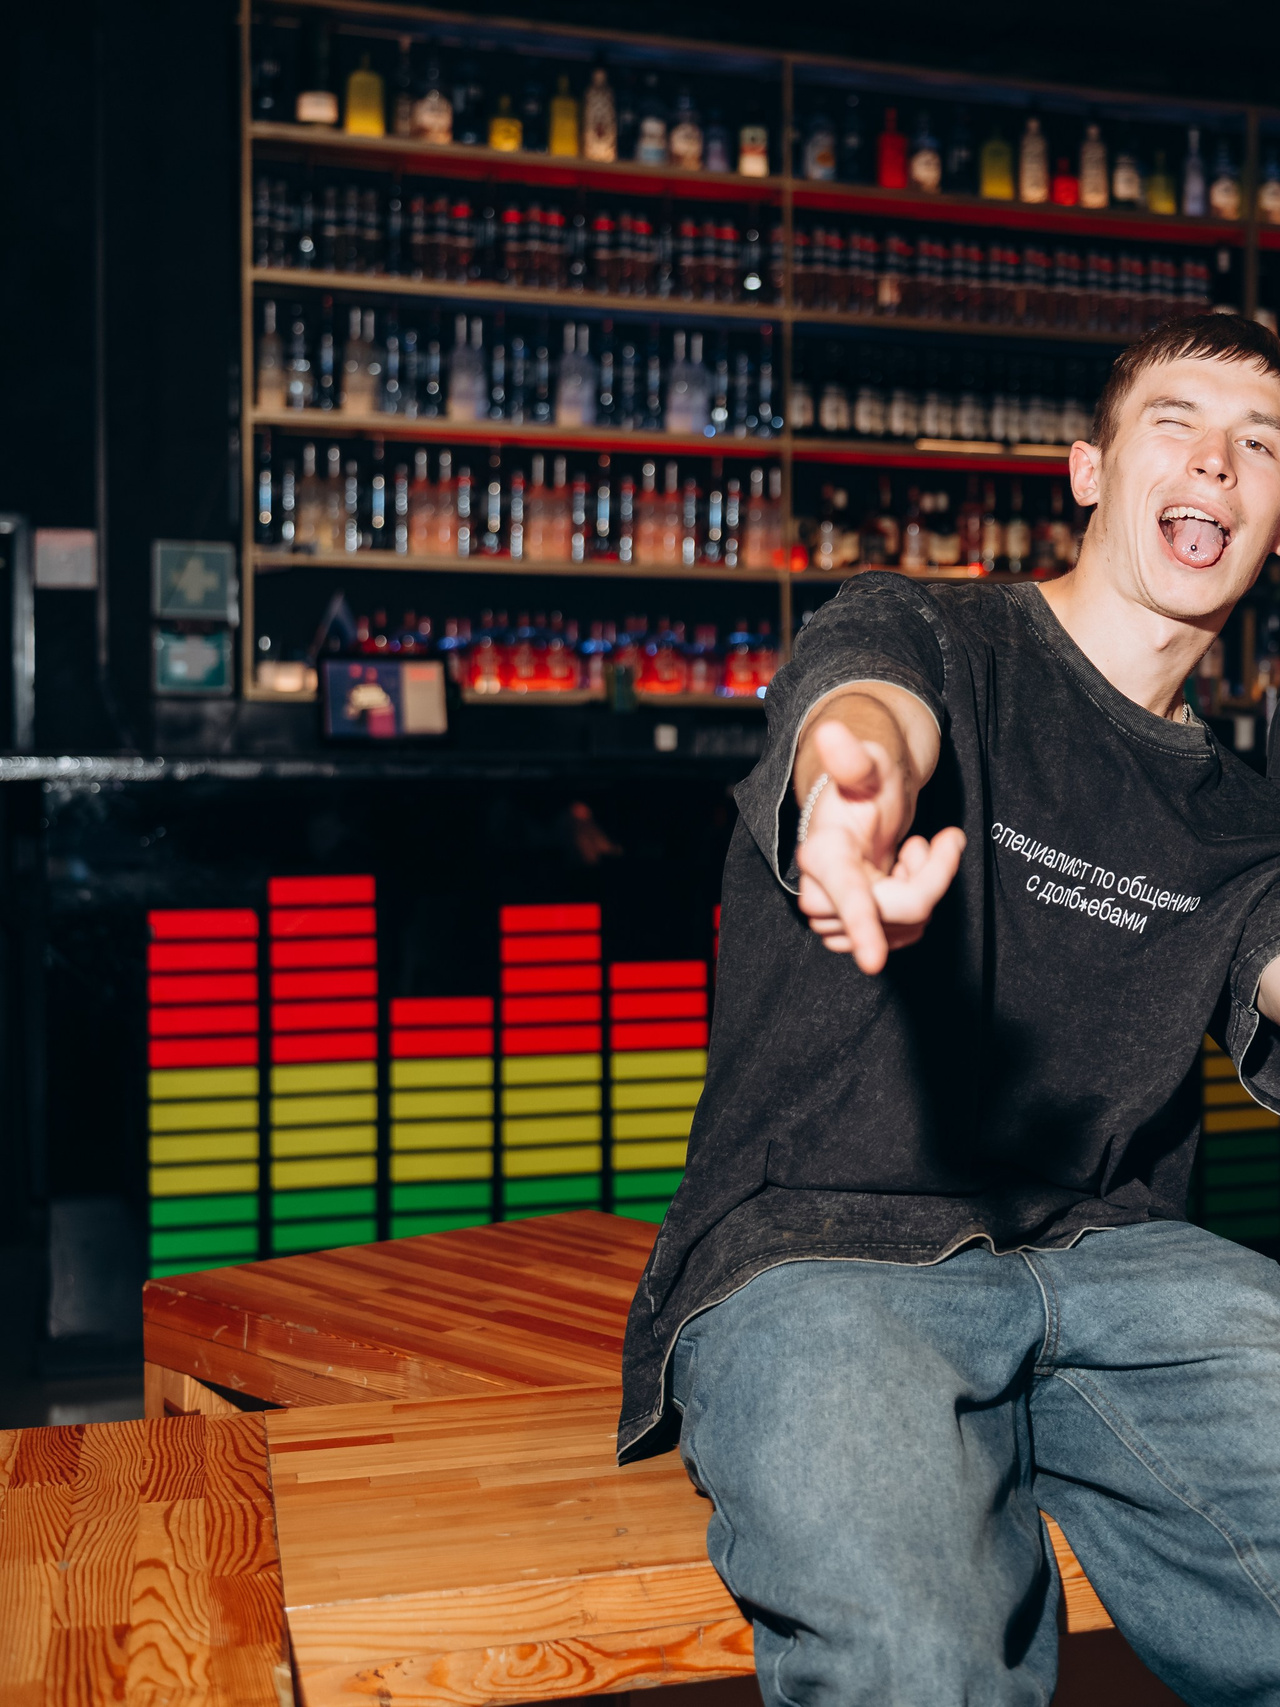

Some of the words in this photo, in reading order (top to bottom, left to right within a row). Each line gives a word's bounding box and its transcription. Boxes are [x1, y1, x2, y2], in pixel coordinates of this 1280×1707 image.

[991, 822, 1093, 881] специалист
[1090, 867, 1115, 890] по
[1117, 876, 1201, 913] общению
[1026, 874, 1041, 893] с
